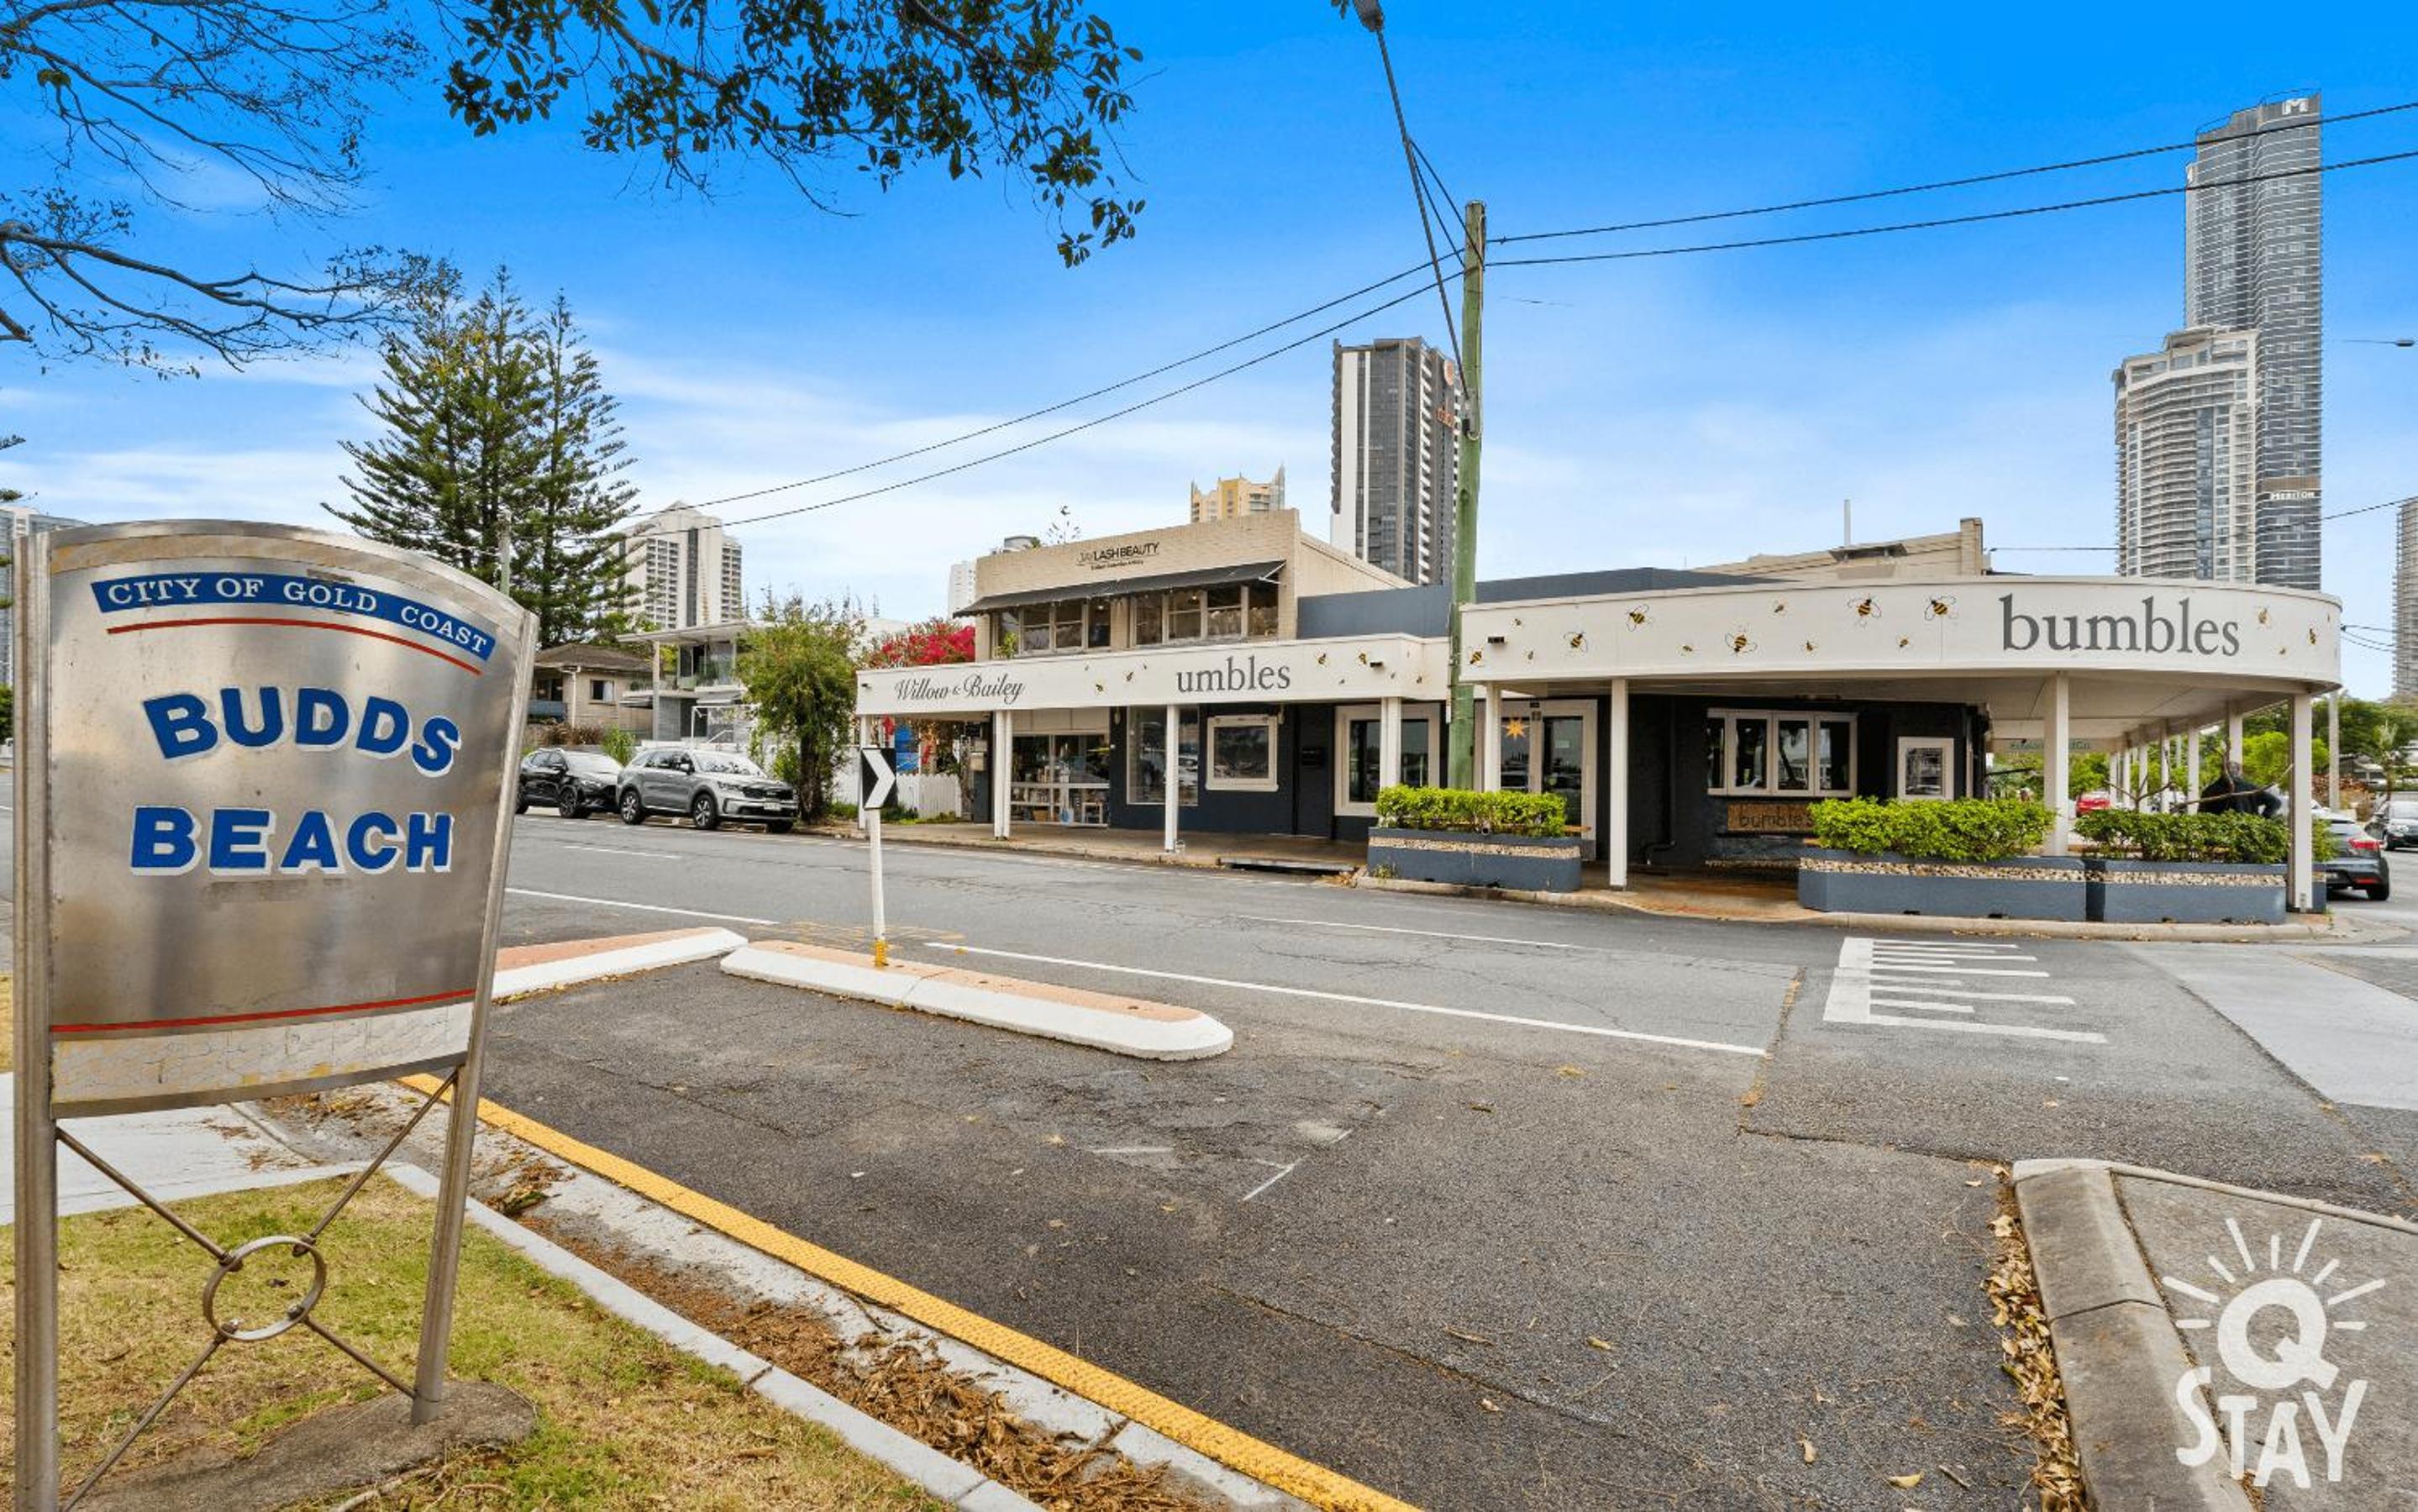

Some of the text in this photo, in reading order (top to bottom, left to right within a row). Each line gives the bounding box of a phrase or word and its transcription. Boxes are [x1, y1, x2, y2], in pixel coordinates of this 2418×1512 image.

[108, 578, 487, 655] CITY OF GOLD COAST
[1999, 593, 2240, 657] bumbles
[895, 677, 949, 701] Willow
[964, 674, 1024, 706] Bailey
[1176, 655, 1290, 693] umbles
[143, 686, 461, 777] BUDDS
[129, 806, 455, 876] BEACH
